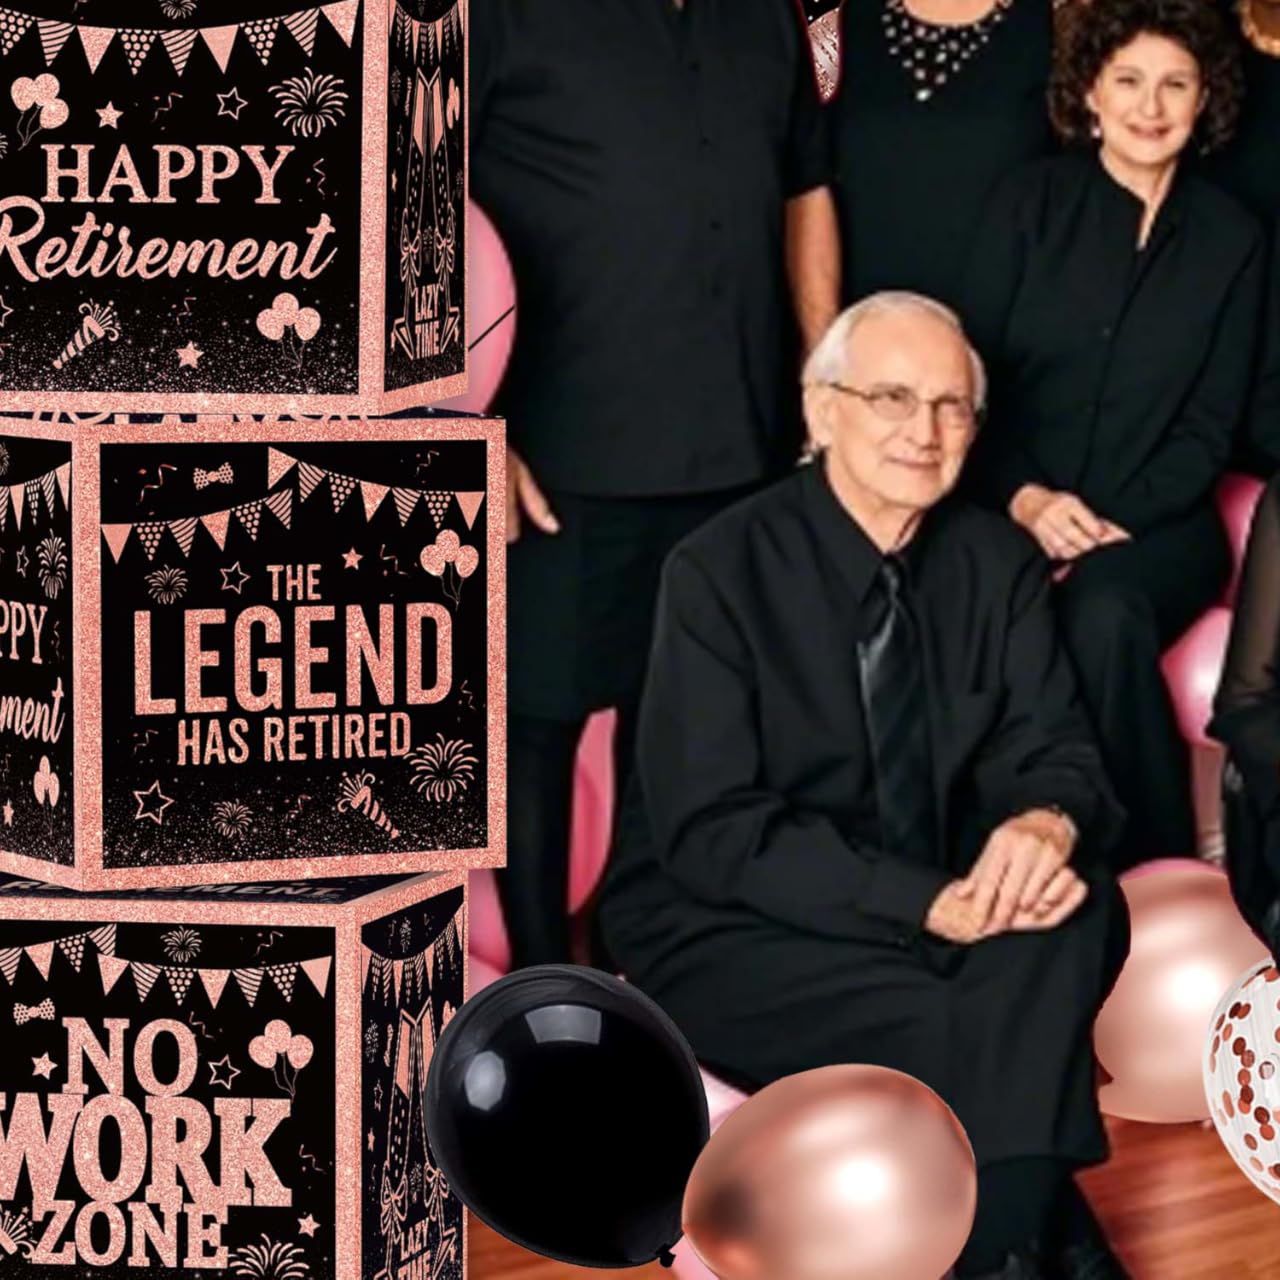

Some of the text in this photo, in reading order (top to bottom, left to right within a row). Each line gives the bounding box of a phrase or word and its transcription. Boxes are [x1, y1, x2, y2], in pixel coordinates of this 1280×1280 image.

[40, 143, 296, 204] HAPPY
[0, 195, 338, 283] Retirement
[415, 283, 440, 322] LAZY
[415, 320, 440, 359] TIME
[266, 563, 322, 601] THE
[134, 602, 453, 716] LEGEND
[177, 711, 411, 766] HAS RETIRED
[62, 1016, 198, 1098] NO
[0, 1092, 293, 1208] WORK
[31, 1199, 229, 1269] ZONE
